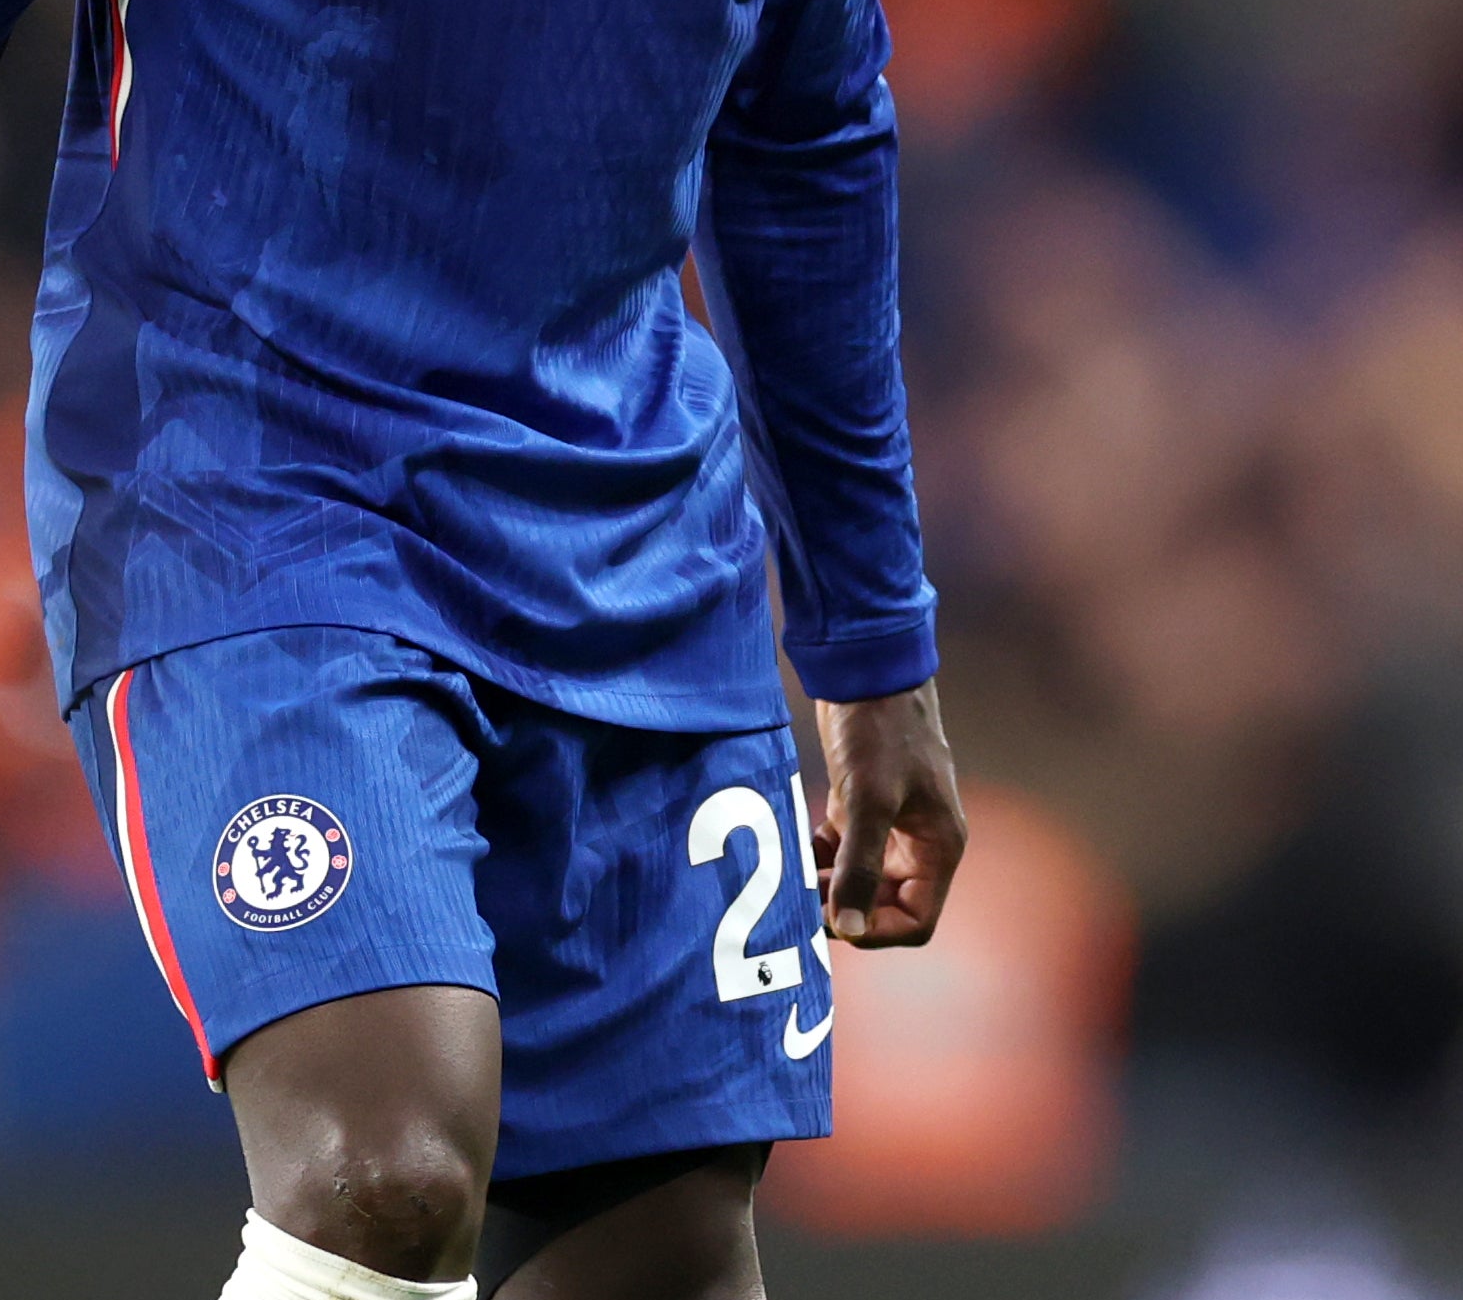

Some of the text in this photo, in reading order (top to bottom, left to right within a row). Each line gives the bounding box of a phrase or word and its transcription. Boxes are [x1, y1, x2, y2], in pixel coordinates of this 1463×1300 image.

[227, 799, 314, 843] CHELSEA
[243, 884, 335, 925] FOOTBALL CLUB
